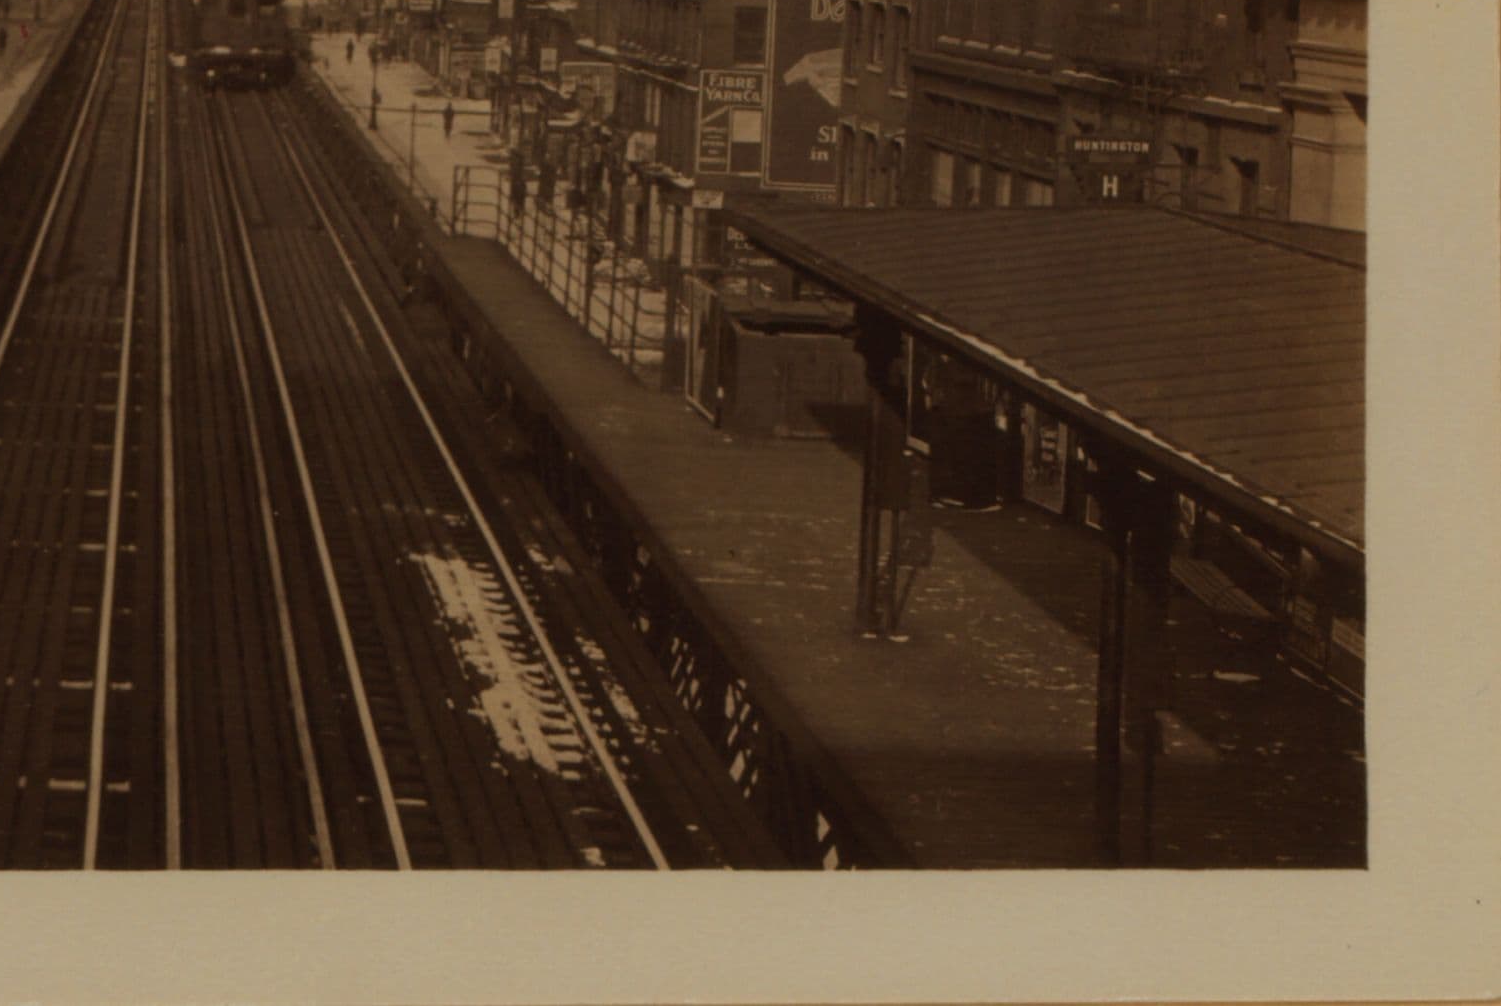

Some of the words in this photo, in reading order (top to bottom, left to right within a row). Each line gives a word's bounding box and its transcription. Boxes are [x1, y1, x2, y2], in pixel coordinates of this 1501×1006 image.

[709, 73, 757, 90] FIBRE
[809, 145, 829, 161] in
[1074, 140, 1150, 153] HUNTINGTON
[1102, 175, 1119, 199] H
